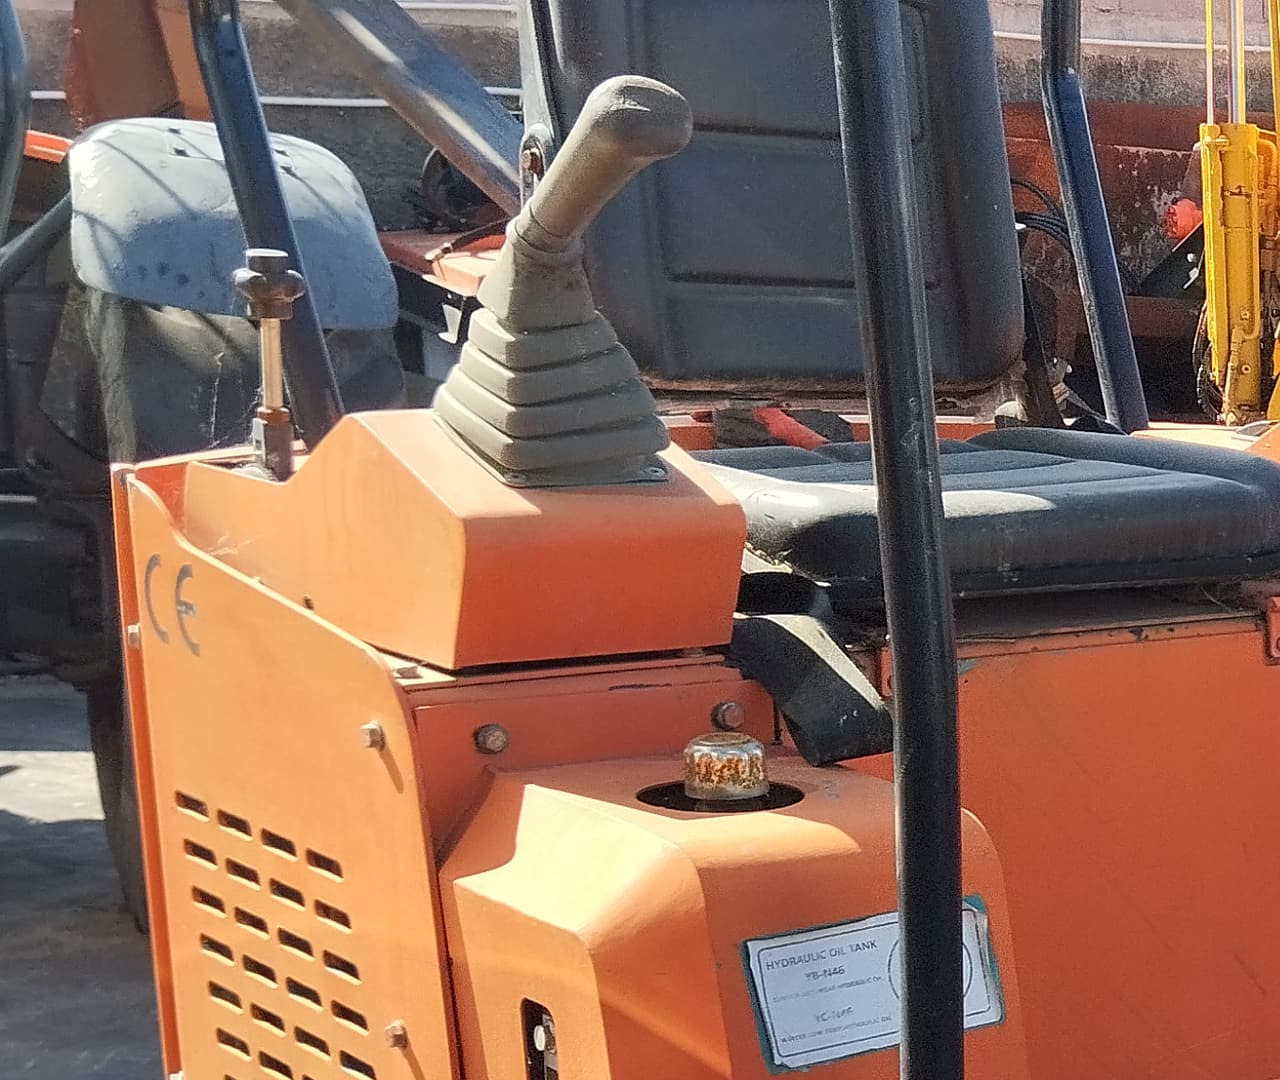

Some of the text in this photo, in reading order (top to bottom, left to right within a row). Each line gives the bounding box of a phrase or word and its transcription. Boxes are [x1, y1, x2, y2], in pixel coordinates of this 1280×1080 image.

[766, 939, 878, 971] HYDRAULIC OIL TANK
